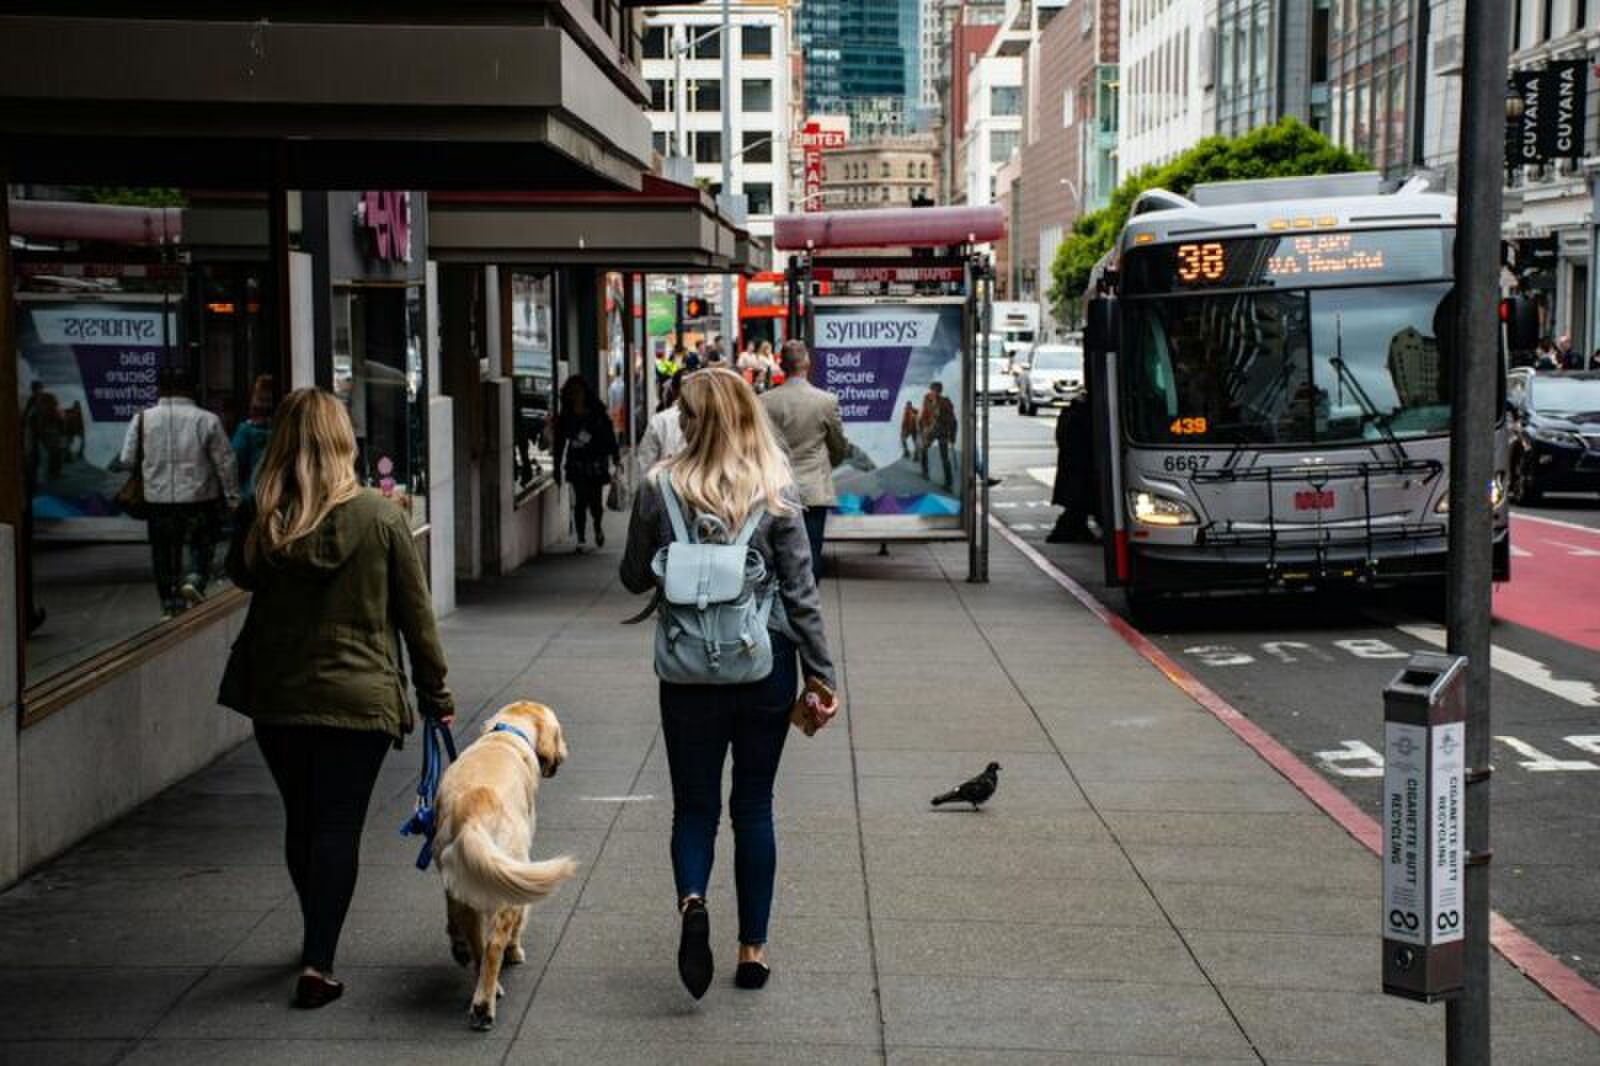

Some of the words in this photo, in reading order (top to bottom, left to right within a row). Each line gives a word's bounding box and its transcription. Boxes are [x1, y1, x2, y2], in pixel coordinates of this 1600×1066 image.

[1522, 77, 1540, 159] CUYANA
[1556, 67, 1576, 151] CUYANA
[1178, 243, 1224, 280] 38
[826, 353, 861, 367] Build
[826, 370, 875, 384] Secure
[835, 403, 870, 416] aster
[1163, 455, 1211, 471] 6667
[1391, 792, 1403, 865] RECYCLING
[1406, 778, 1418, 850] CIGARETTE
[1406, 850, 1417, 885] BUTT
